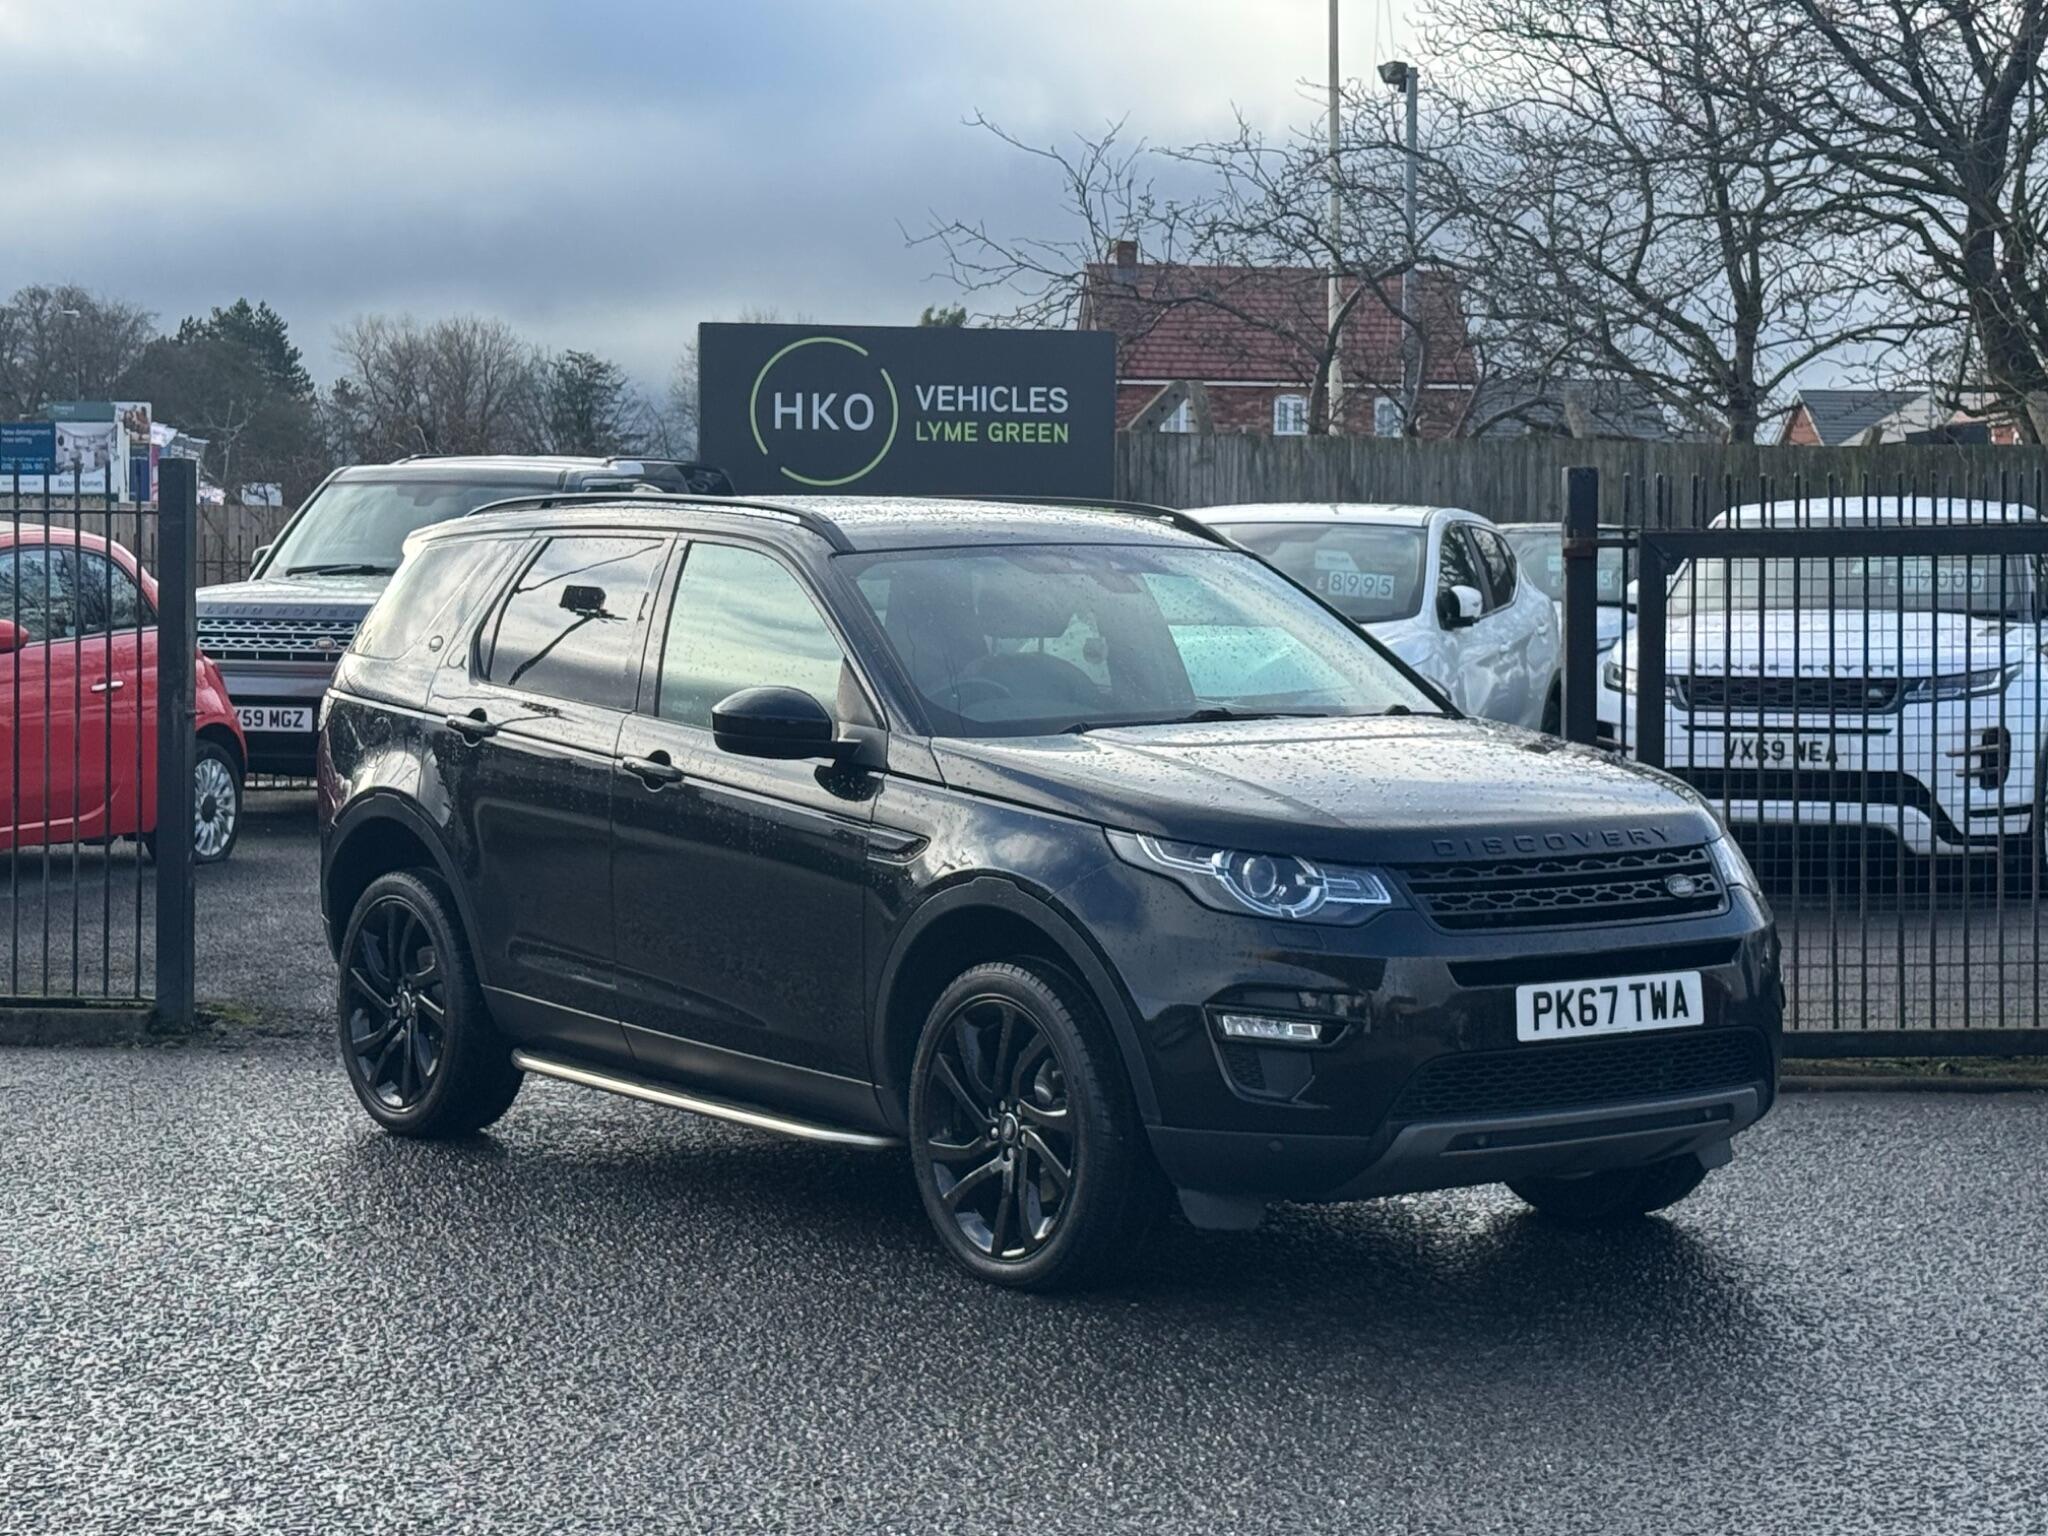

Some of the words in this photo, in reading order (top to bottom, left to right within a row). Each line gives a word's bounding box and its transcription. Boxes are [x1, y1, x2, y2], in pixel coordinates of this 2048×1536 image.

[774, 392, 875, 431] HKO
[915, 384, 1069, 413] VEHICLES
[915, 421, 978, 442] LYME
[988, 422, 1069, 443] GREEN
[269, 709, 304, 728] MGZ
[1431, 827, 1671, 857] DISCOVERY
[1532, 984, 1618, 1032] PK67
[1628, 979, 1689, 1022] TWA
